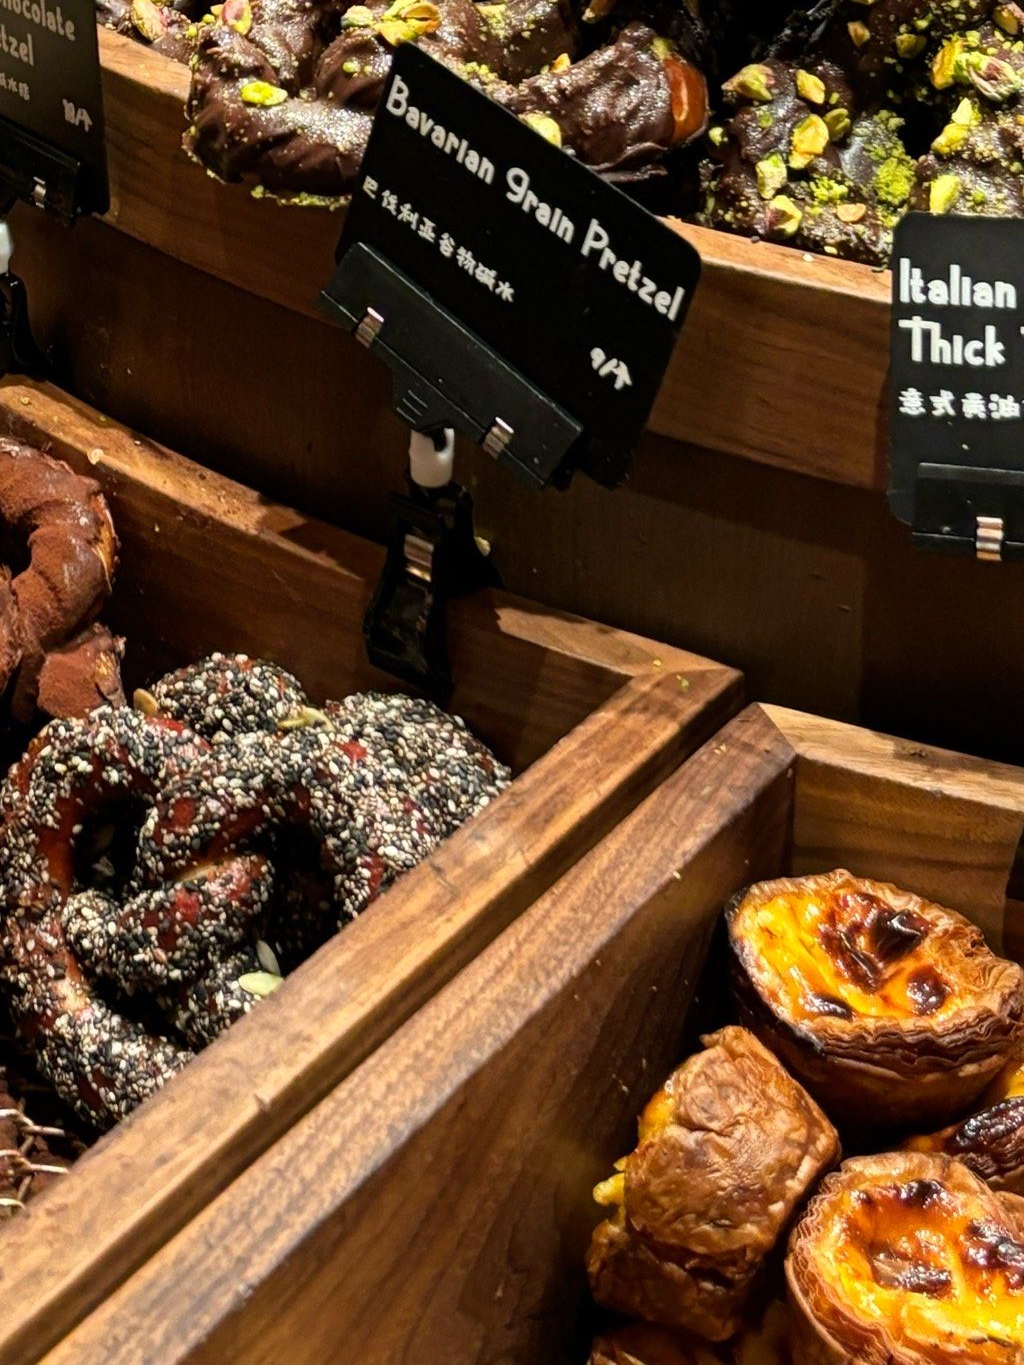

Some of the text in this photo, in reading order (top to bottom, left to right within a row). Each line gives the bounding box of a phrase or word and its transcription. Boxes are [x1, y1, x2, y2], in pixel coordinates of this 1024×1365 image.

[386, 74, 495, 185] Bavarian
[580, 218, 686, 322] Pretzel
[362, 175, 633, 390] 巴伐利亚谷物碱水 9/个
[899, 257, 1017, 309] Italian
[898, 316, 1006, 367] Thick
[898, 387, 1024, 420] 意式黄油
